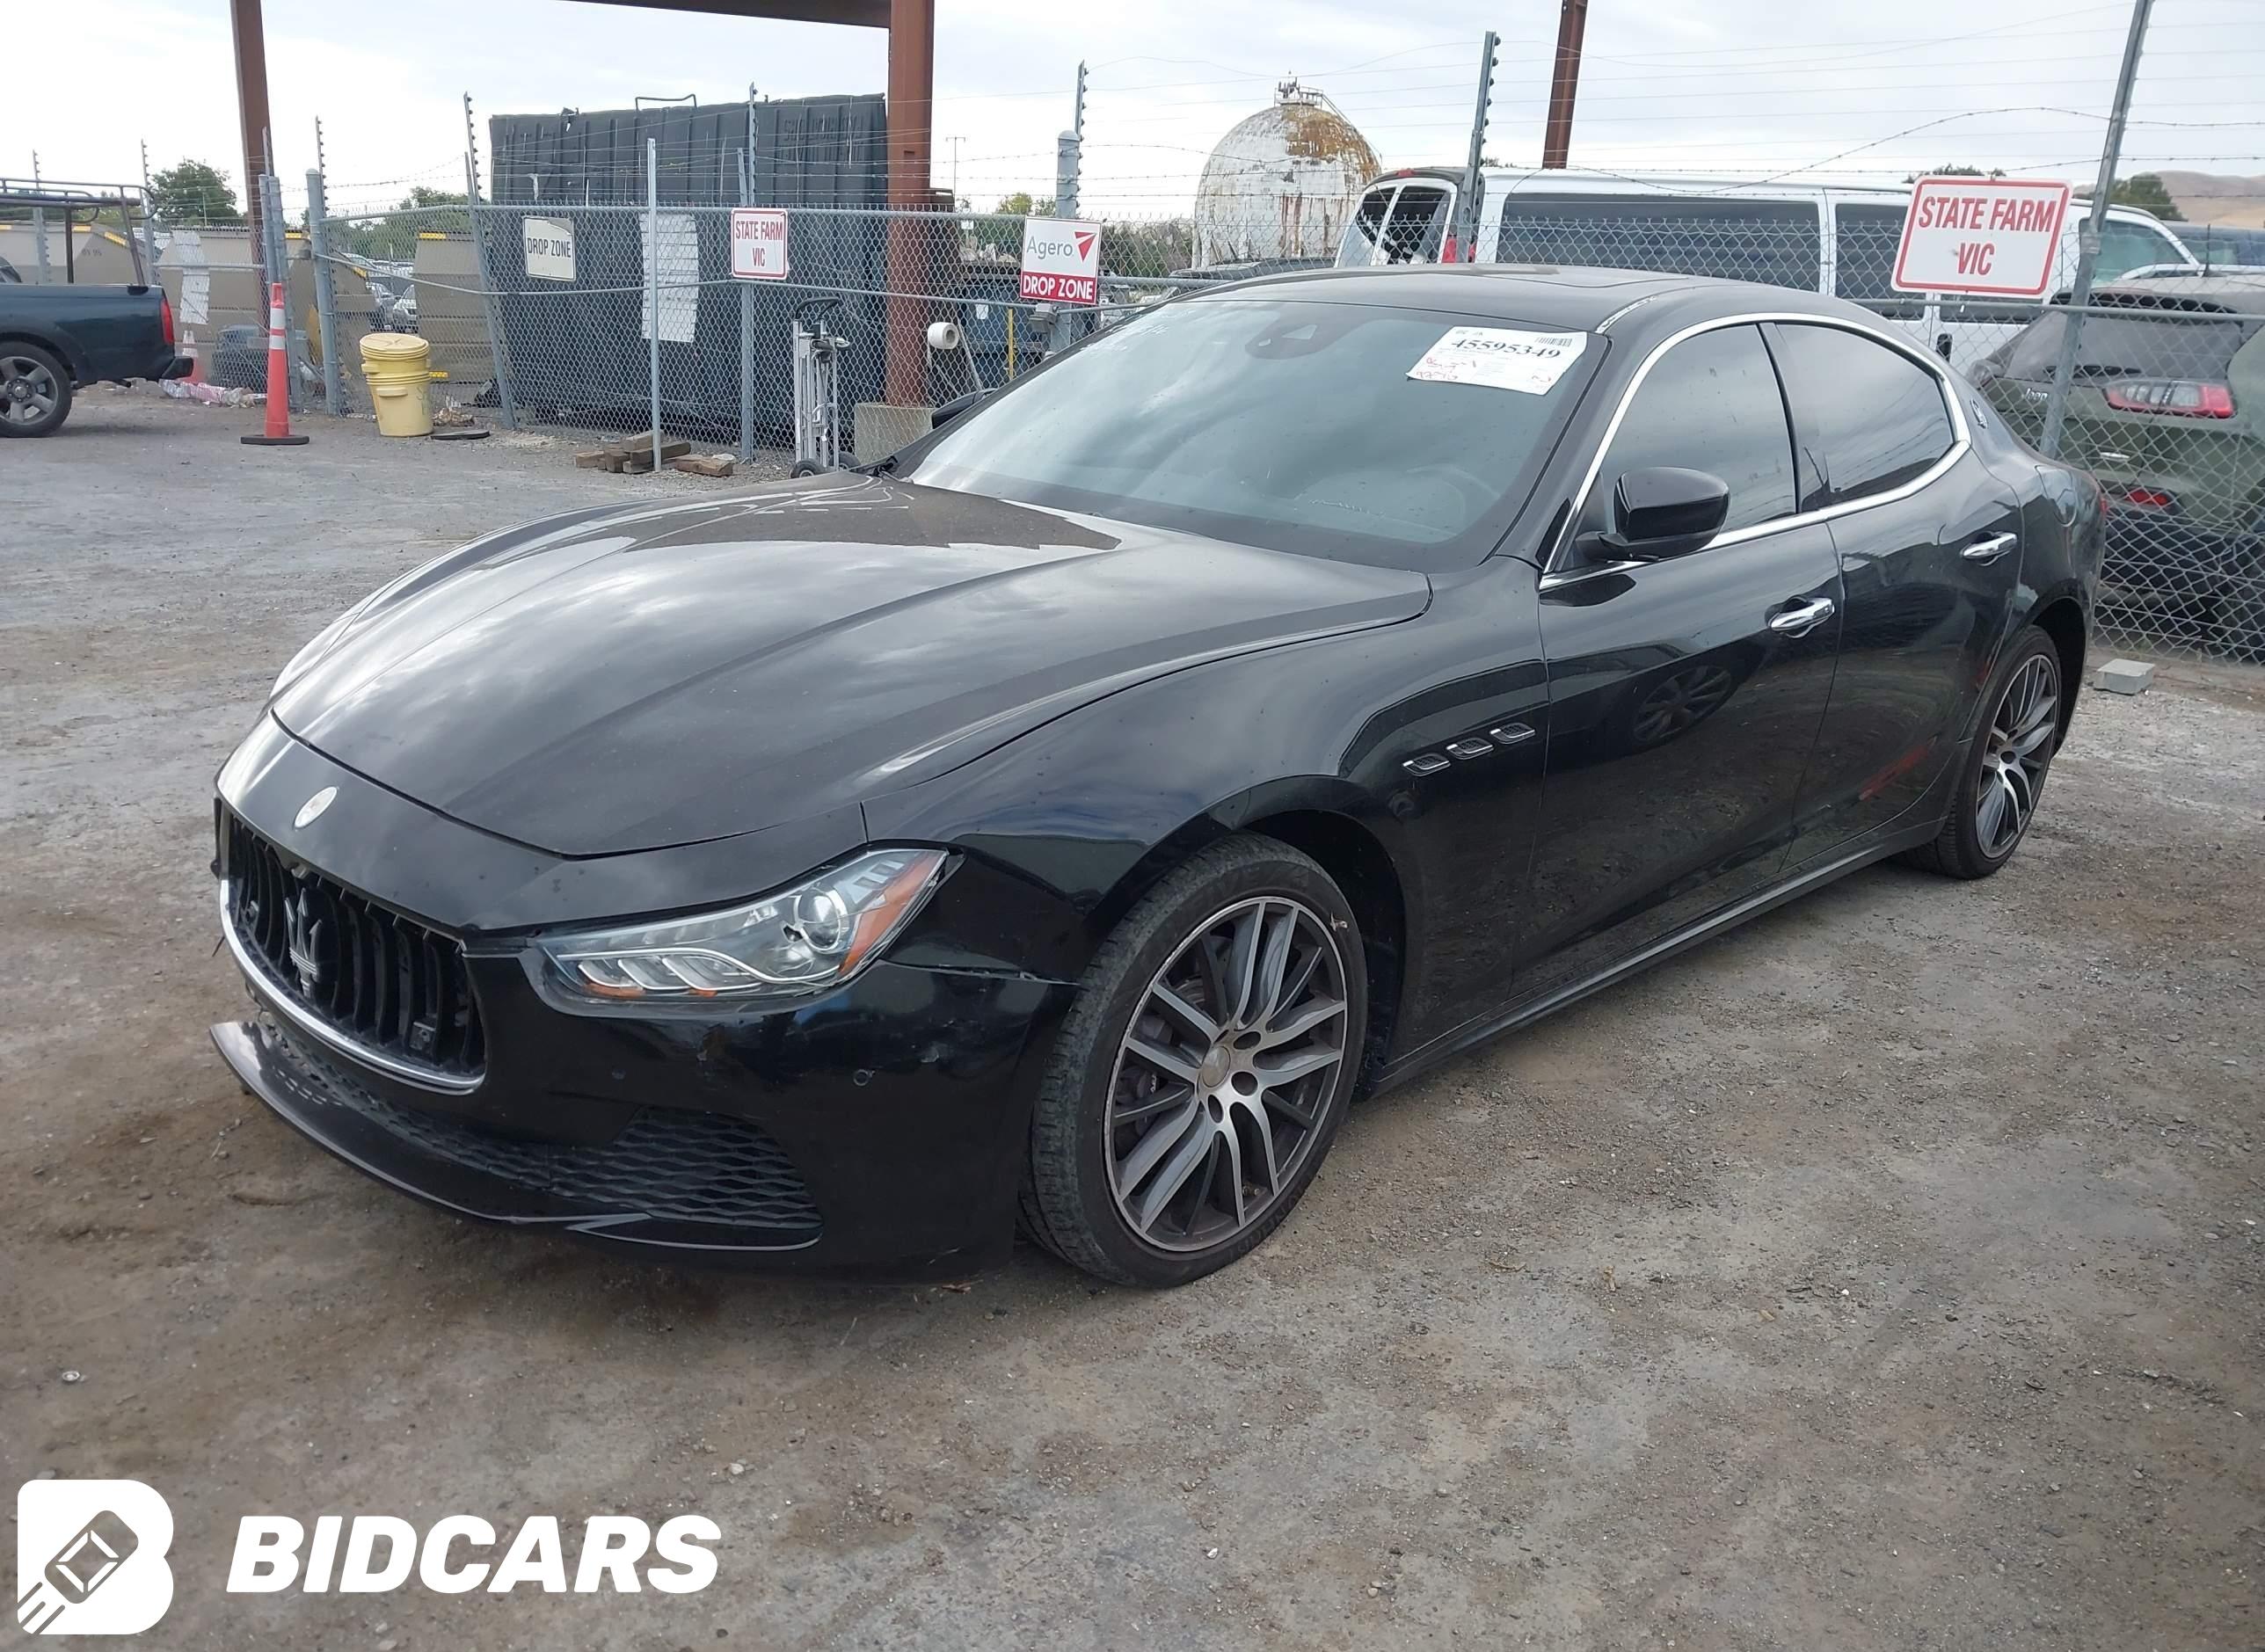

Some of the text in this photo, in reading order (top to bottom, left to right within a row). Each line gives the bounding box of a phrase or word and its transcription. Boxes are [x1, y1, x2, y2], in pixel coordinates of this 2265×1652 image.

[1919, 196, 2057, 233] STATE FARM
[736, 221, 783, 241] STATE FARM
[528, 238, 572, 258] DROP ZONE
[753, 248, 765, 266] VIC
[1027, 236, 1073, 260] Agero
[1958, 243, 1995, 275] VIC
[1023, 274, 1093, 300] DROP ZONE
[1451, 338, 1562, 359] 45595349
